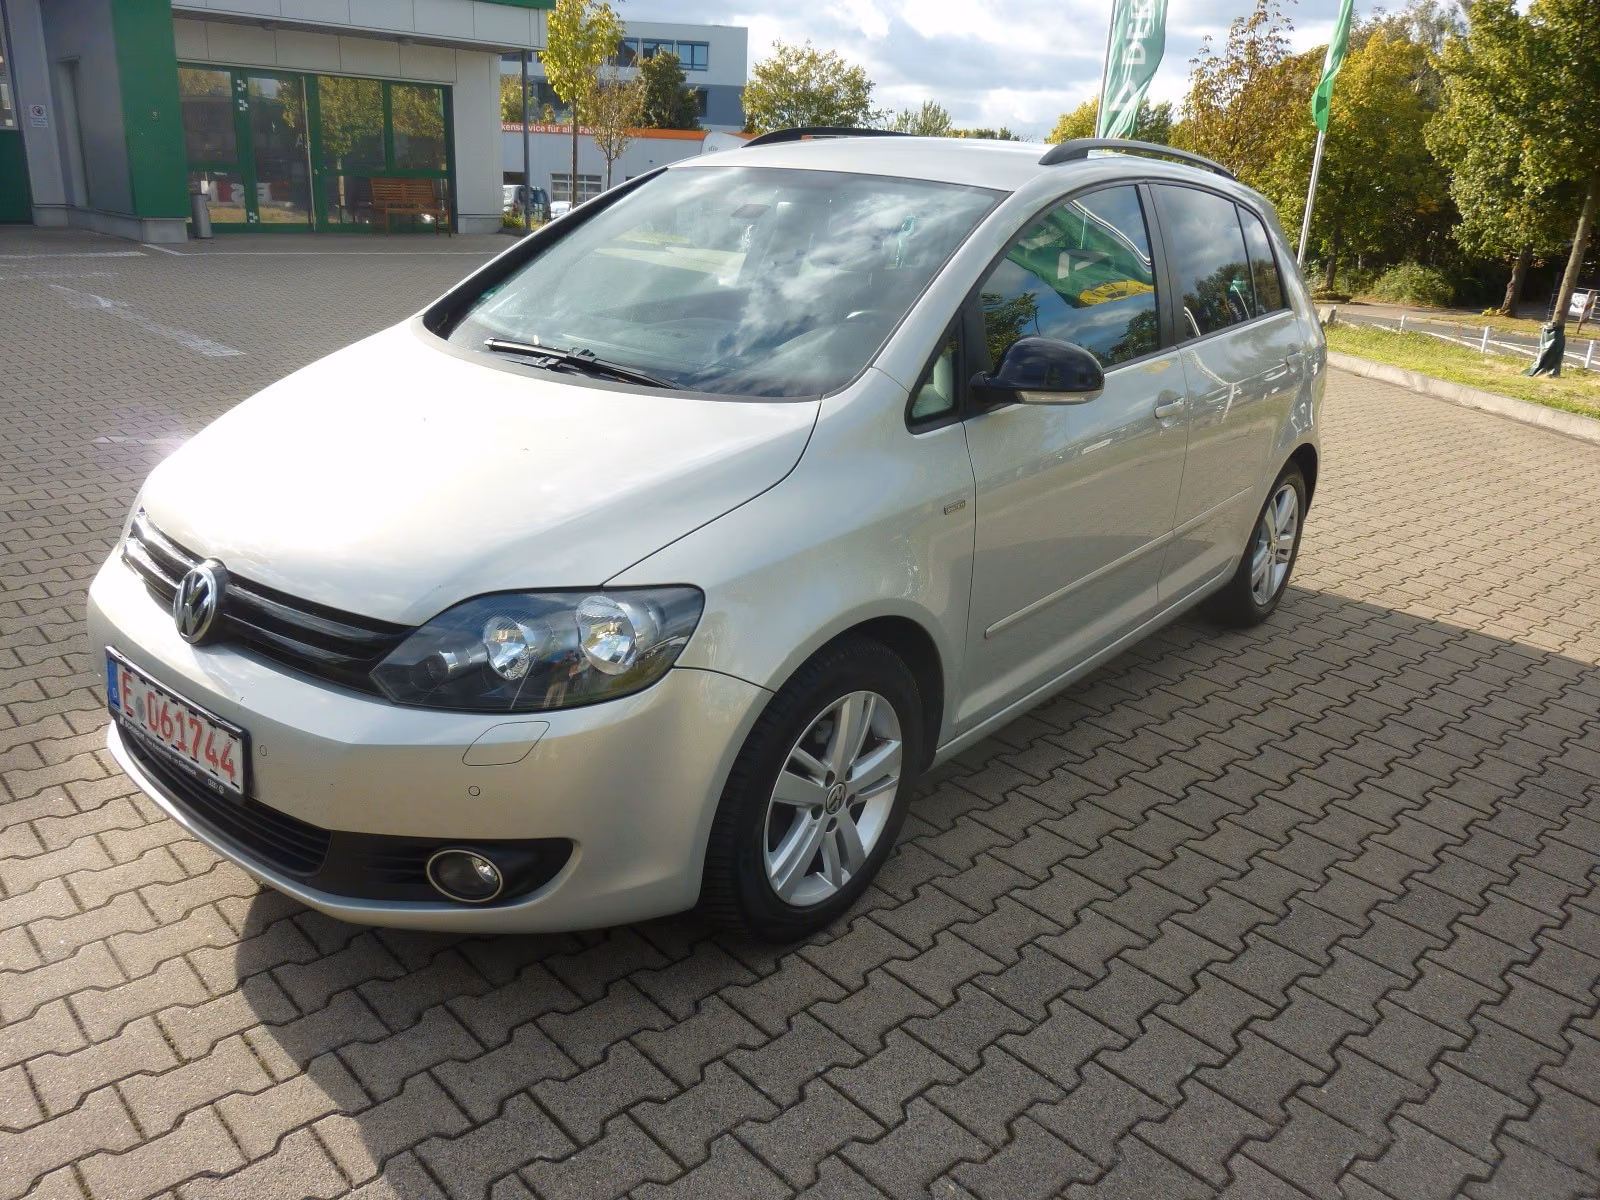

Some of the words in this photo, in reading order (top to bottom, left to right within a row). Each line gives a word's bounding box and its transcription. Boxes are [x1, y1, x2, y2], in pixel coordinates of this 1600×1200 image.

[501, 123, 546, 133] kensevice
[547, 124, 560, 134] für
[121, 671, 135, 717] E
[146, 691, 237, 781] 061744
